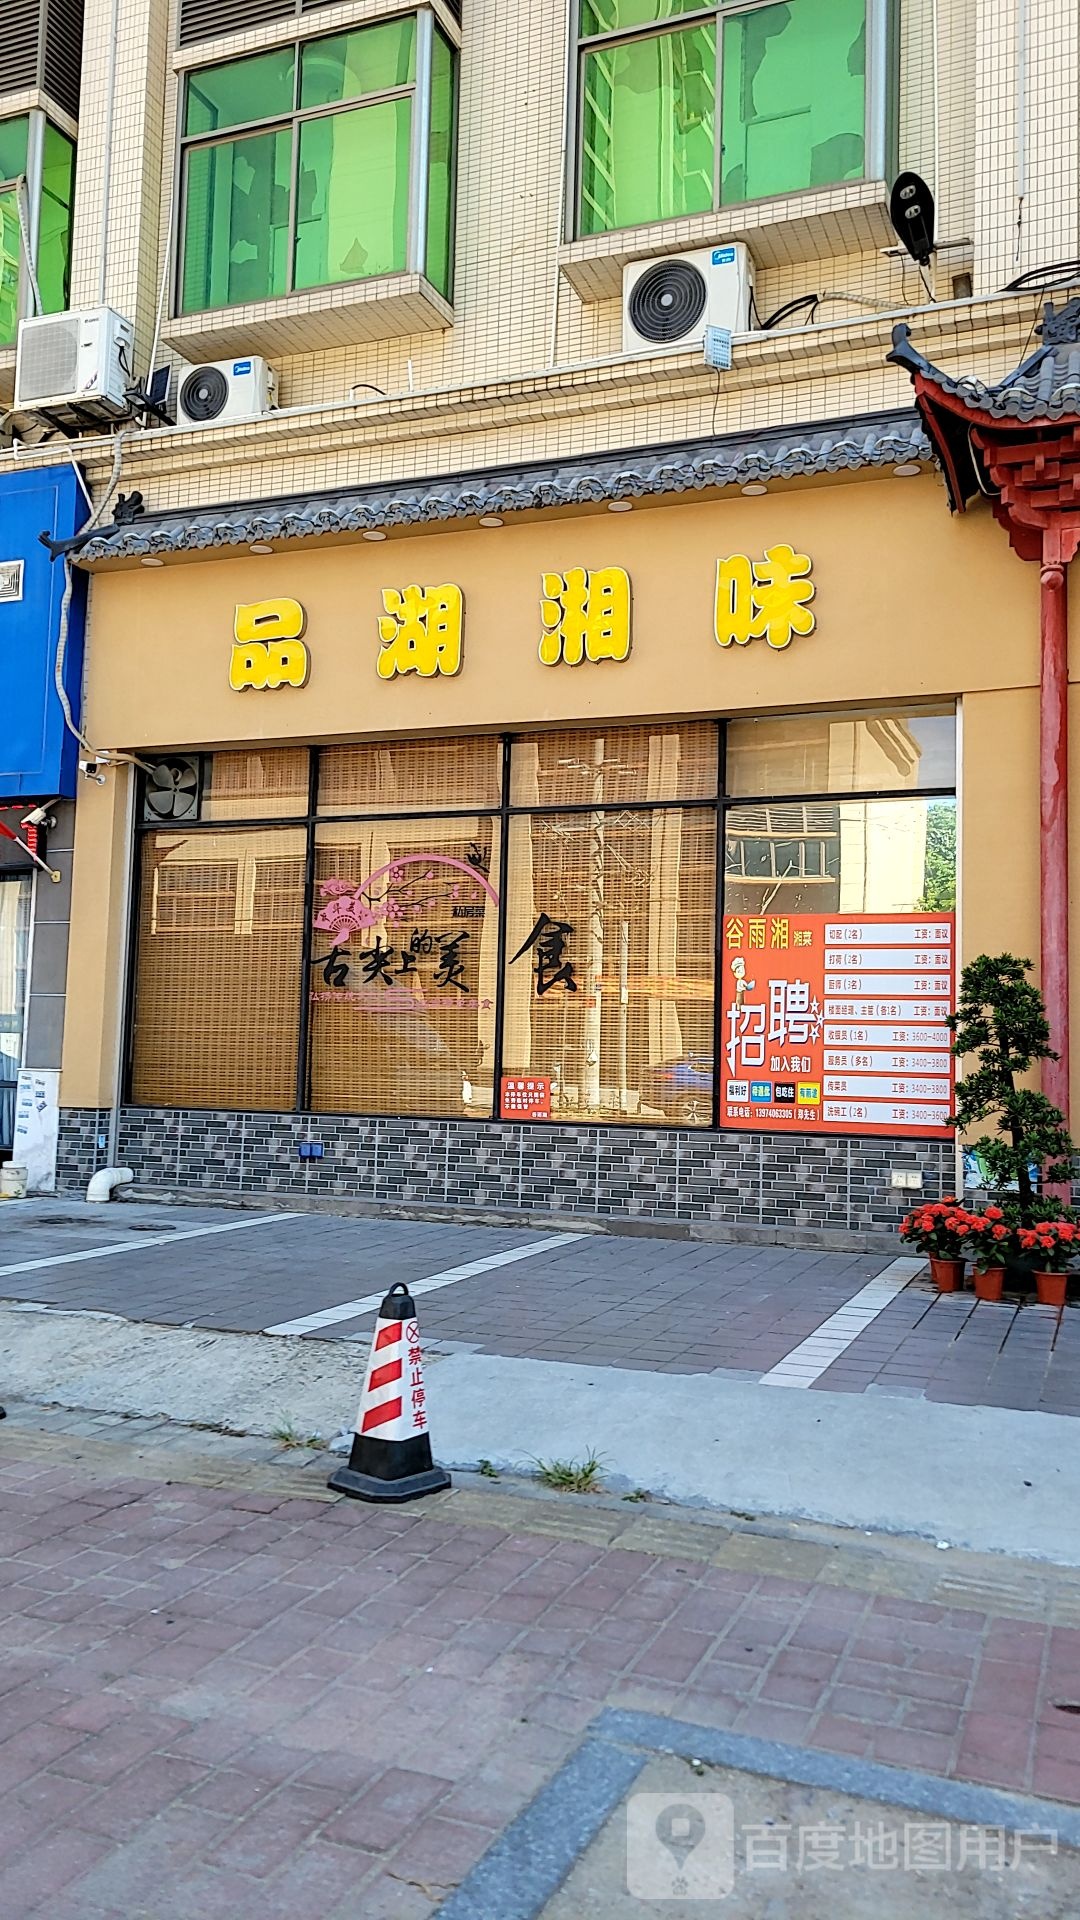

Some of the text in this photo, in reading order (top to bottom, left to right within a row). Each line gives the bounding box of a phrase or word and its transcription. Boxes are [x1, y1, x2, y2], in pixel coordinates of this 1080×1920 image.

[229, 543, 817, 691] 品湖湘味
[725, 917, 813, 949] 谷雨湘 湘菜
[726, 979, 818, 1078] 招聘
[770, 1055, 811, 1073] 加入我们
[507, 1081, 545, 1090] 温馨提示
[729, 1085, 747, 1096] 福利好
[775, 1086, 795, 1098] 包吃住
[408, 1346, 428, 1429] 禁止停车
